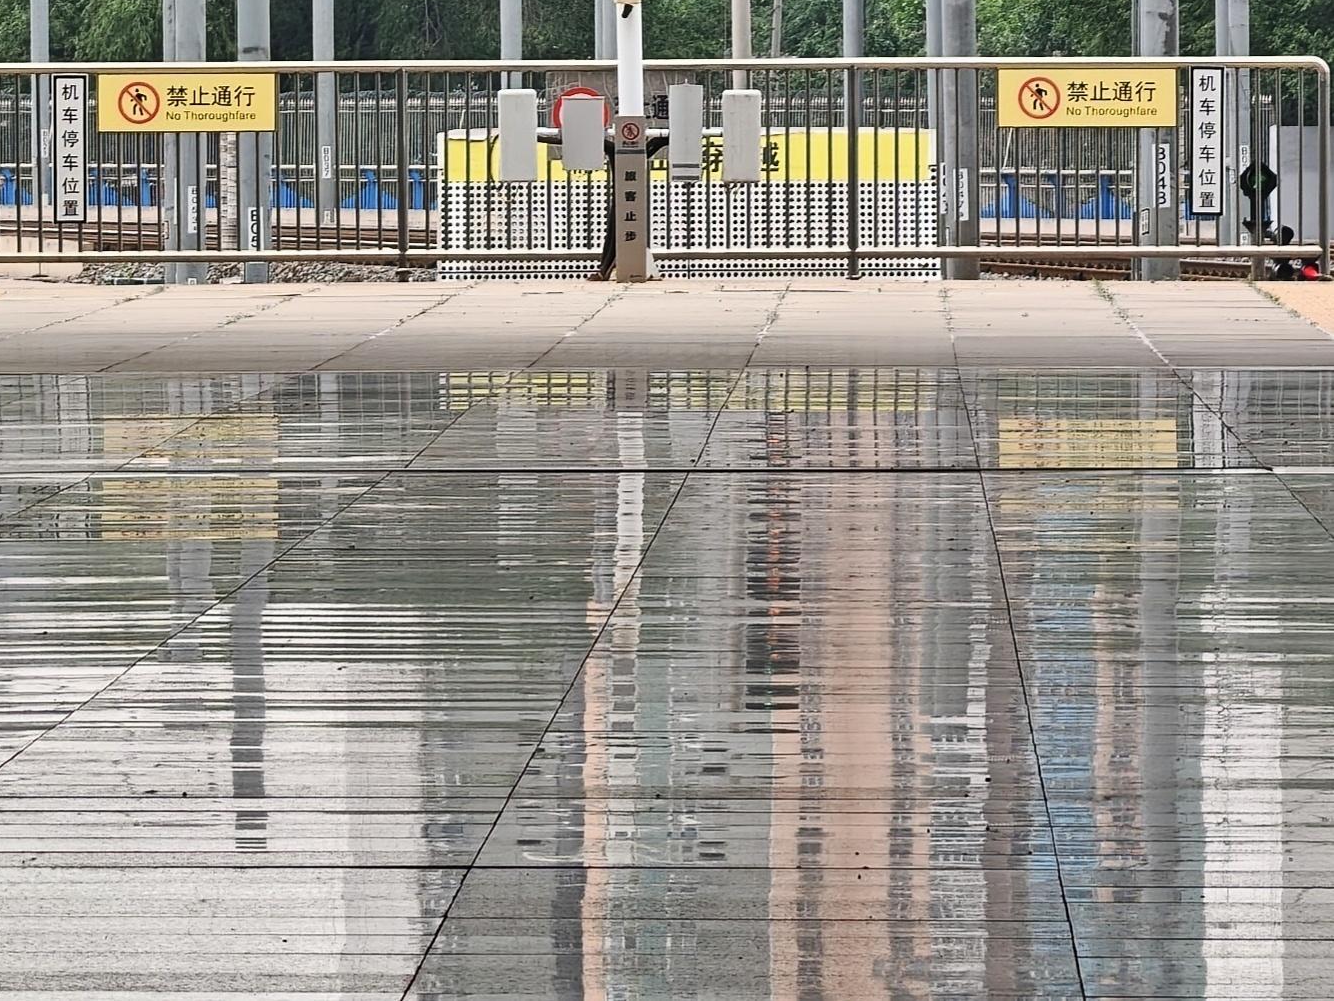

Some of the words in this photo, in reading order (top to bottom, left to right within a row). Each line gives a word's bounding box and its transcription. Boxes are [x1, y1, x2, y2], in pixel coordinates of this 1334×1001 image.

[166, 85, 256, 108] 禁止通行
[1066, 80, 1157, 103] 禁止通行
[166, 110, 181, 120] No
[184, 110, 257, 122] Thoroughfare
[1066, 106, 1082, 116] No
[1085, 106, 1158, 118] Thoroughfare
[60, 82, 80, 217] 机车停车位置
[1197, 75, 1217, 209] 机车停车位置
